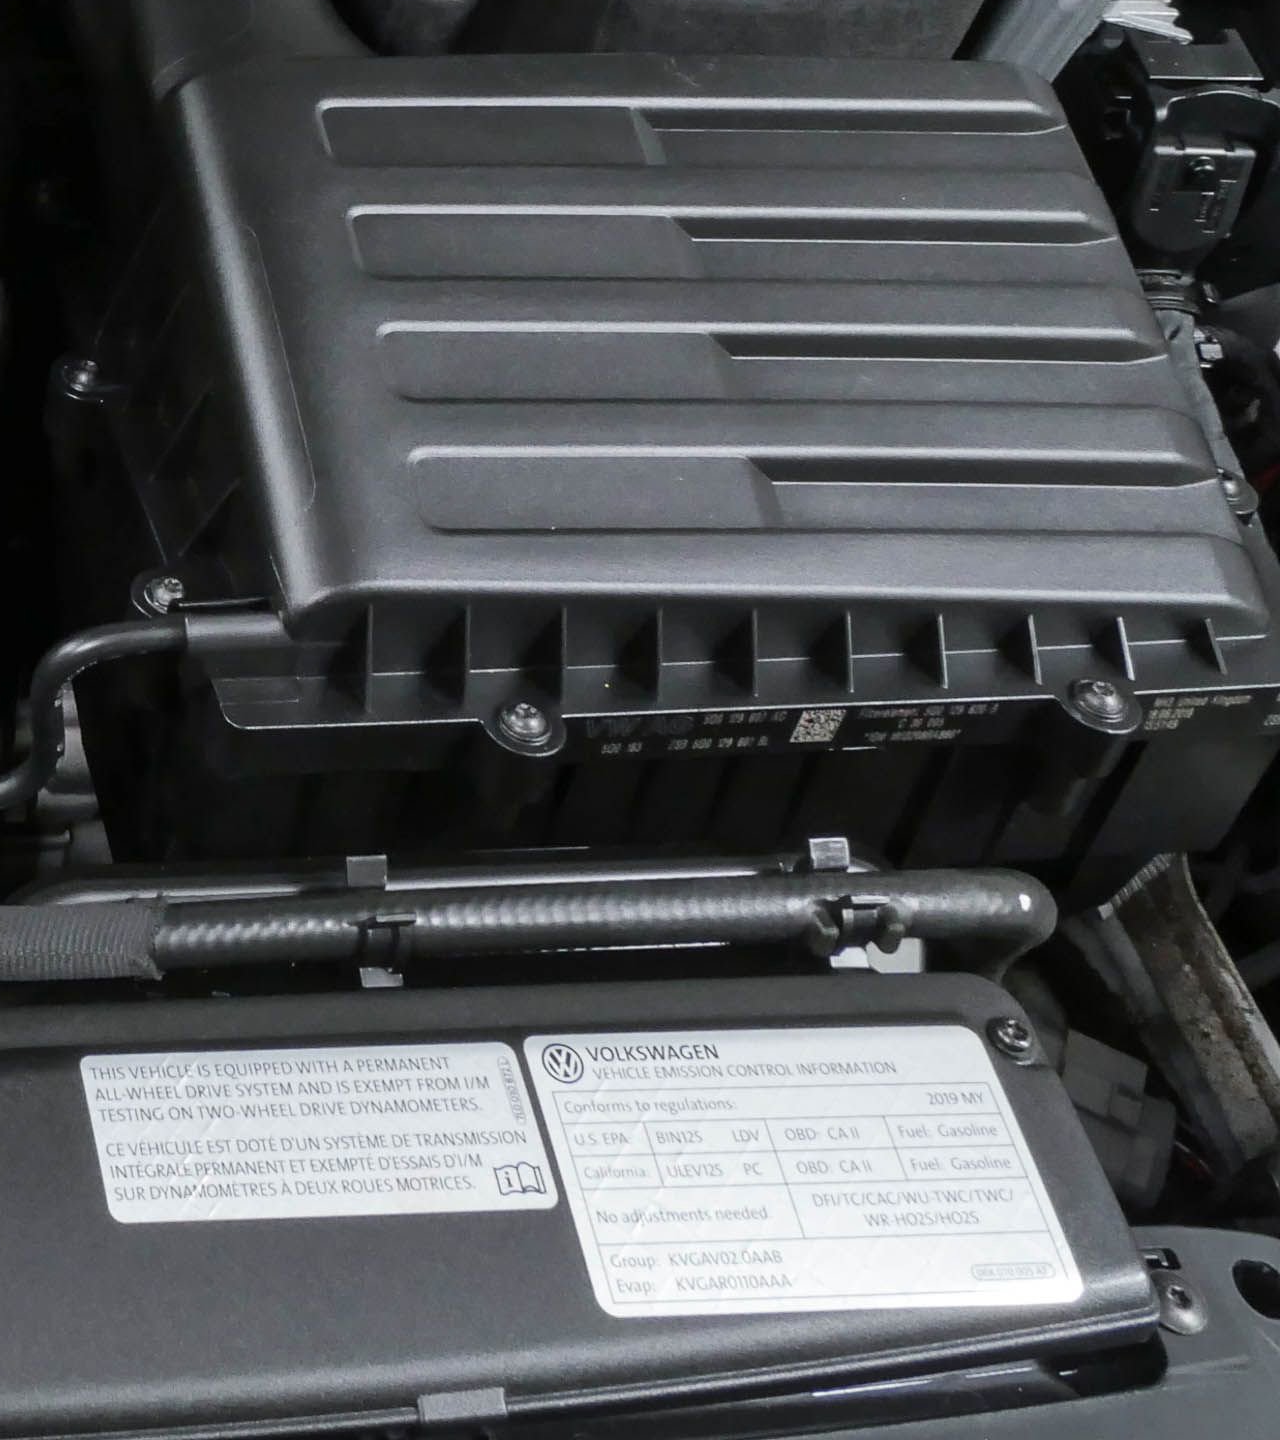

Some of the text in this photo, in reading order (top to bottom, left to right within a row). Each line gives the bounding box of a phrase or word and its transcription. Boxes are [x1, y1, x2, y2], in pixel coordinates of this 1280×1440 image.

[584, 1043, 719, 1062] VOLKSWAGEN
[88, 1055, 449, 1080] THIS VEHICLE IS EQUIPPED WITH A PERMANENT
[591, 1060, 897, 1080] VEHICLE EMISSION CONTROL INFORMATION
[94, 1084, 182, 1102] ALL-WHEEL
[184, 1083, 232, 1099] DRIVE
[234, 1080, 294, 1097] SYSTEM
[297, 1080, 333, 1096] AND
[335, 1079, 351, 1094] IS
[352, 1077, 411, 1094] EXEMPT
[415, 1076, 461, 1091] FROM
[97, 1106, 165, 1122] TESTING
[167, 1105, 194, 1121] ON
[196, 1102, 296, 1120] TWO-WHEEL
[298, 1100, 346, 1116] DRIVE
[563, 1099, 633, 1115] Conforms
[633, 1099, 651, 1113] to
[926, 1091, 959, 1105] 2019
[959, 1091, 983, 1104] MY
[936, 1122, 998, 1137] Gasoline
[948, 1154, 1012, 1171] Gasoline
